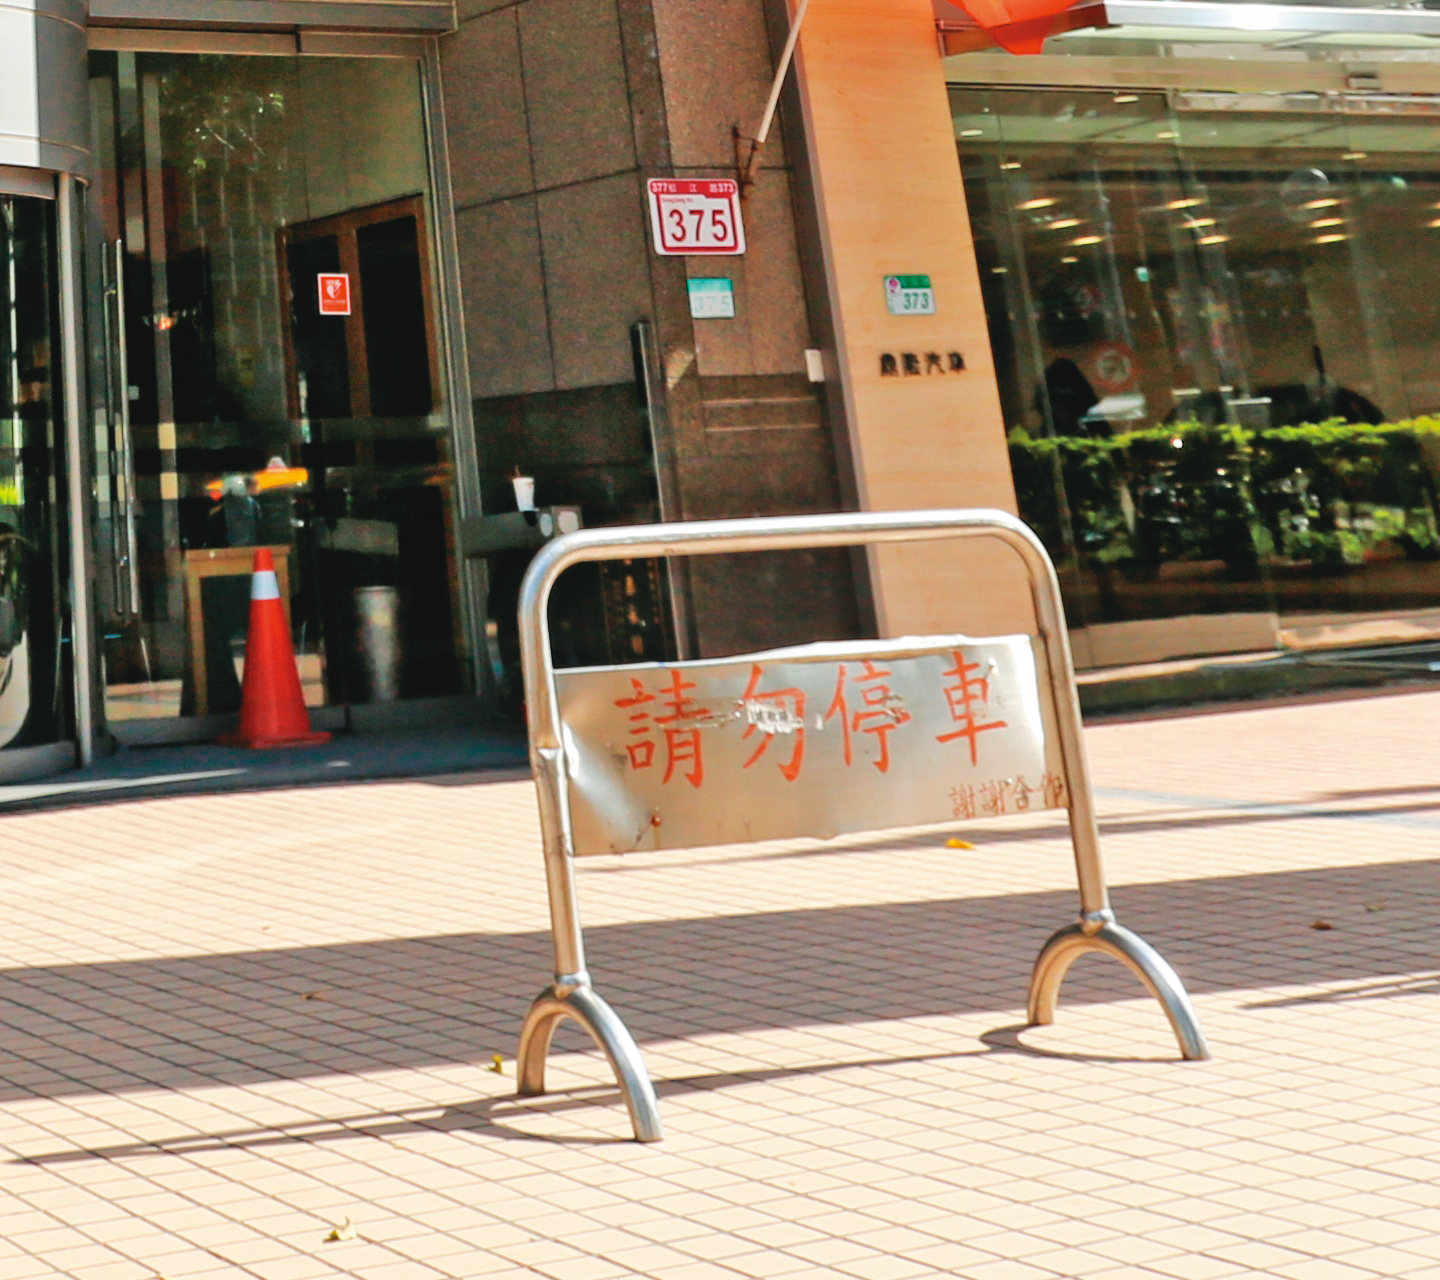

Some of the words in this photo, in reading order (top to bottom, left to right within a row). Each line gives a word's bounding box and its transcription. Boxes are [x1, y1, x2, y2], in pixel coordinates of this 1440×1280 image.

[669, 208, 729, 242] 375
[693, 295, 733, 314] 375
[902, 292, 931, 311] 373
[613, 651, 1008, 788] 請勿停車
